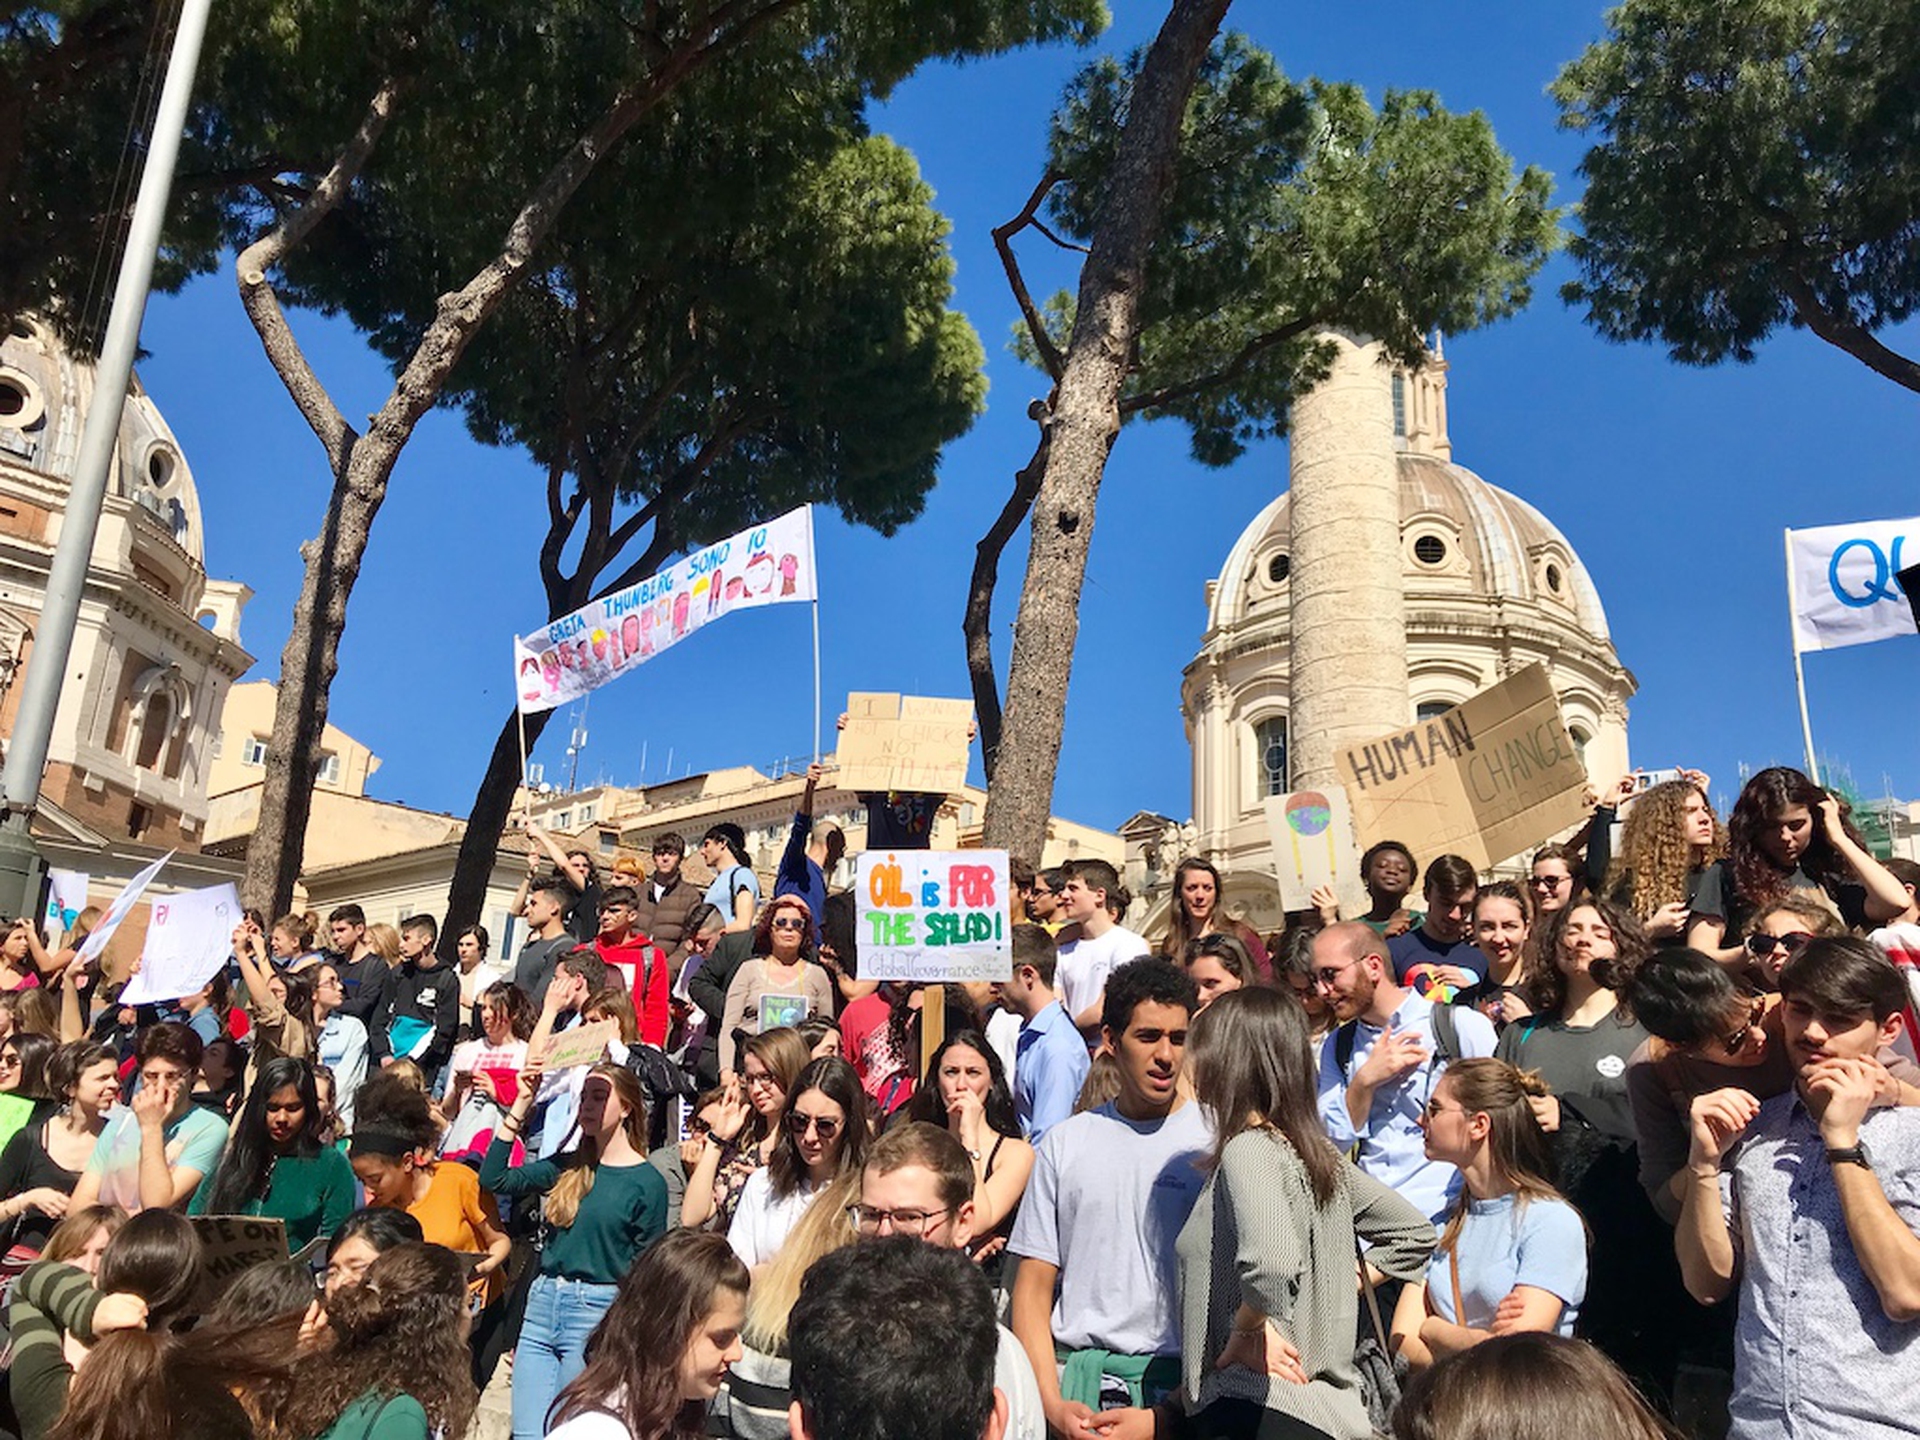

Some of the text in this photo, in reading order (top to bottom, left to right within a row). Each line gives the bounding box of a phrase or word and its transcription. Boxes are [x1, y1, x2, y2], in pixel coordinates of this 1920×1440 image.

[549, 528, 768, 644] GRETA THUNBERG SONO IO
[864, 698, 879, 717] I
[881, 739, 923, 756] NOT
[897, 723, 967, 749] CHICKS
[1347, 710, 1477, 791] HUMAN
[1467, 715, 1574, 804] CHANGE
[948, 864, 996, 908] FOR
[865, 911, 1002, 951] THE SALAD!
[243, 1222, 281, 1244] ON
